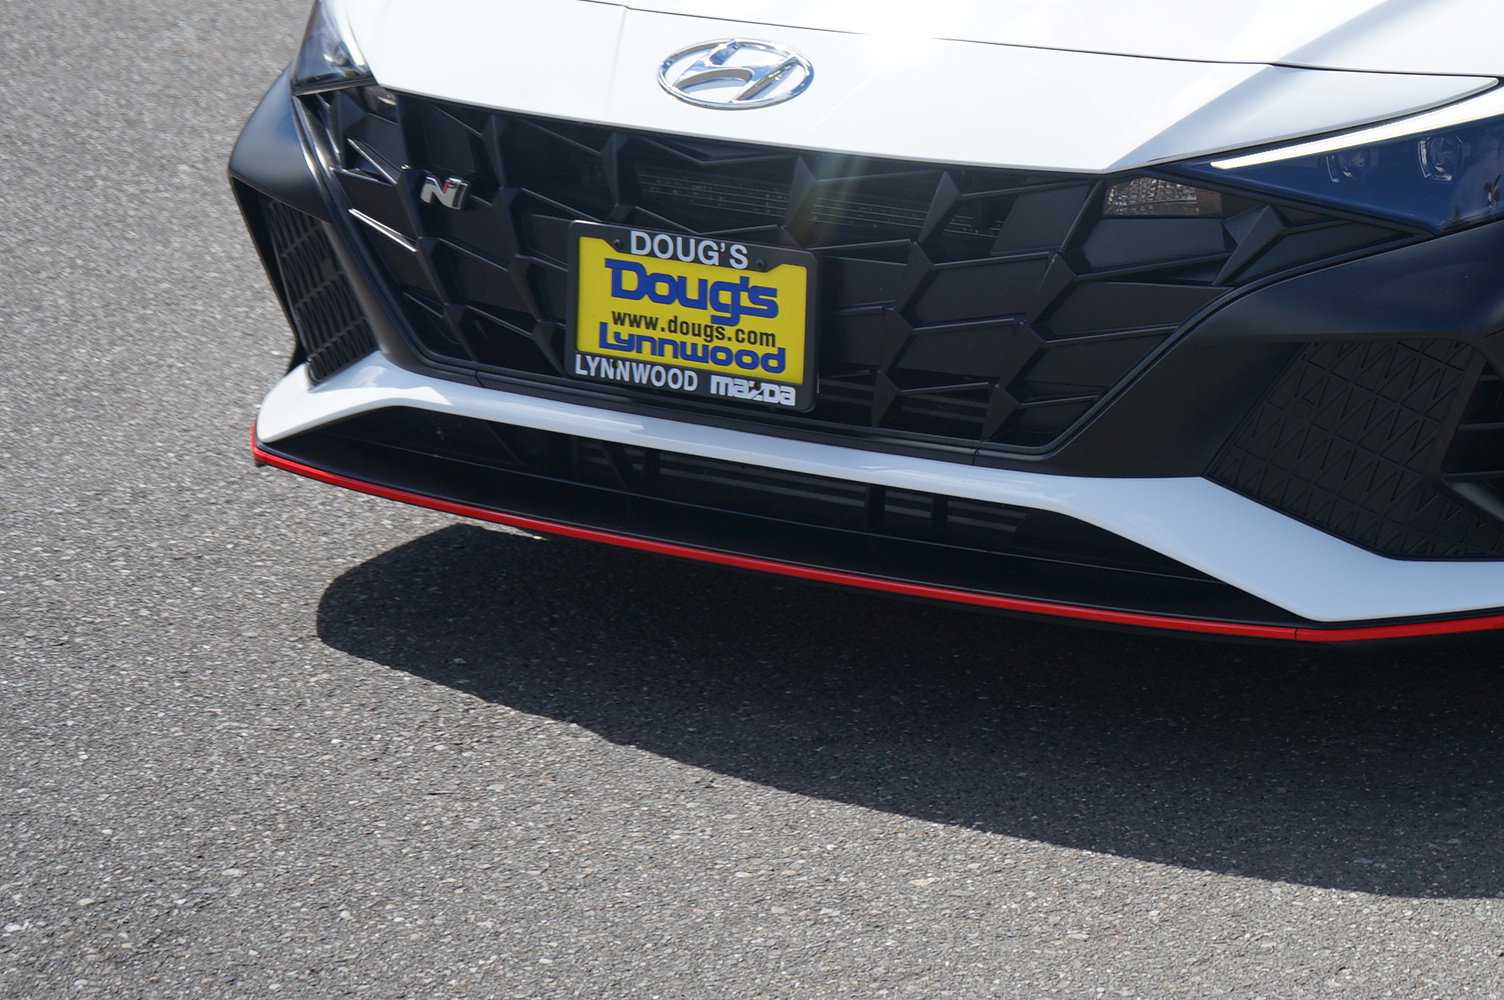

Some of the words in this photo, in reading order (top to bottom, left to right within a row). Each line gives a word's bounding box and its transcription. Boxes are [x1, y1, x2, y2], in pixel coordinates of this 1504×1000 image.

[630, 230, 749, 270] DOUG'S
[599, 321, 786, 373] Lynnwood
[612, 311, 776, 347] www.dougs.com
[575, 353, 698, 391] LYNNWOOD
